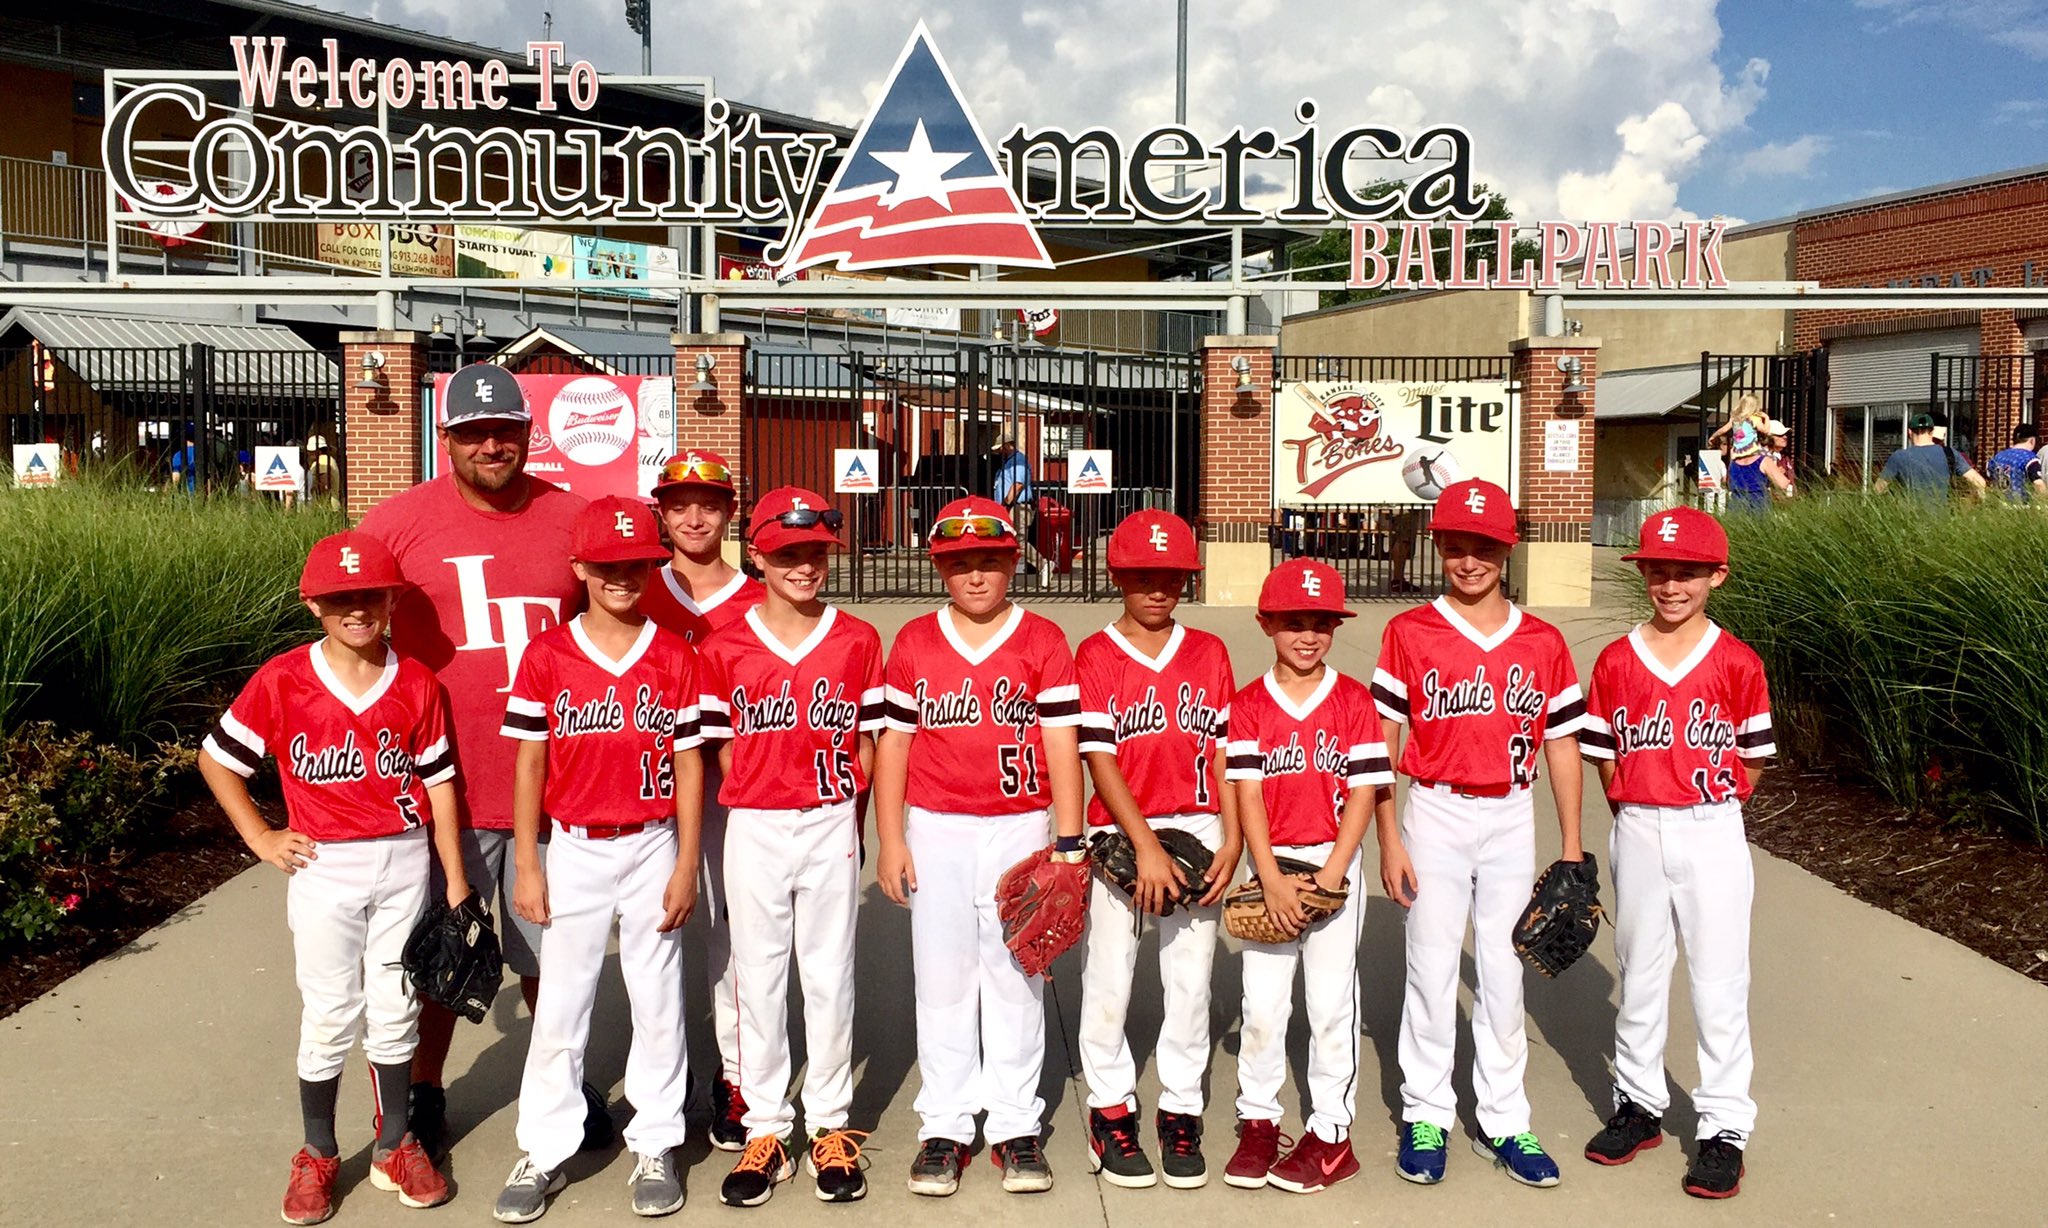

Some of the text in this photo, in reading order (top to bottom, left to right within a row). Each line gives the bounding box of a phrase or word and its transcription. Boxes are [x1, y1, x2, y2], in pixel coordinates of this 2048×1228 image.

[230, 35, 600, 112] Welcome To
[102, 82, 836, 268] Community
[320, 243, 341, 254] CALL
[342, 245, 358, 256] FOR
[459, 225, 523, 242] TOMORROW
[459, 240, 498, 254] STARTS
[1346, 219, 1731, 289] BALLPARK
[568, 412, 620, 427] Budweiser
[1319, 384, 1386, 408] KANSAS CITY
[1398, 384, 1446, 408] Miller
[1416, 394, 1504, 444] Lite
[1282, 434, 1404, 485] T-Bones
[554, 683, 676, 749] Inside Edge
[732, 677, 857, 746] Inside Edge
[915, 677, 1038, 742] Inside Edge
[1176, 682, 1217, 753] Edge
[1422, 663, 1546, 734] Inside Edge
[1260, 731, 1307, 778] nside
[1684, 698, 1737, 768] Edge
[289, 728, 415, 794] Inside Edg
[640, 751, 674, 800] 12
[815, 749, 857, 800] 15
[998, 743, 1040, 798] 51
[1195, 753, 1209, 806] 1
[394, 793, 423, 831] 5
